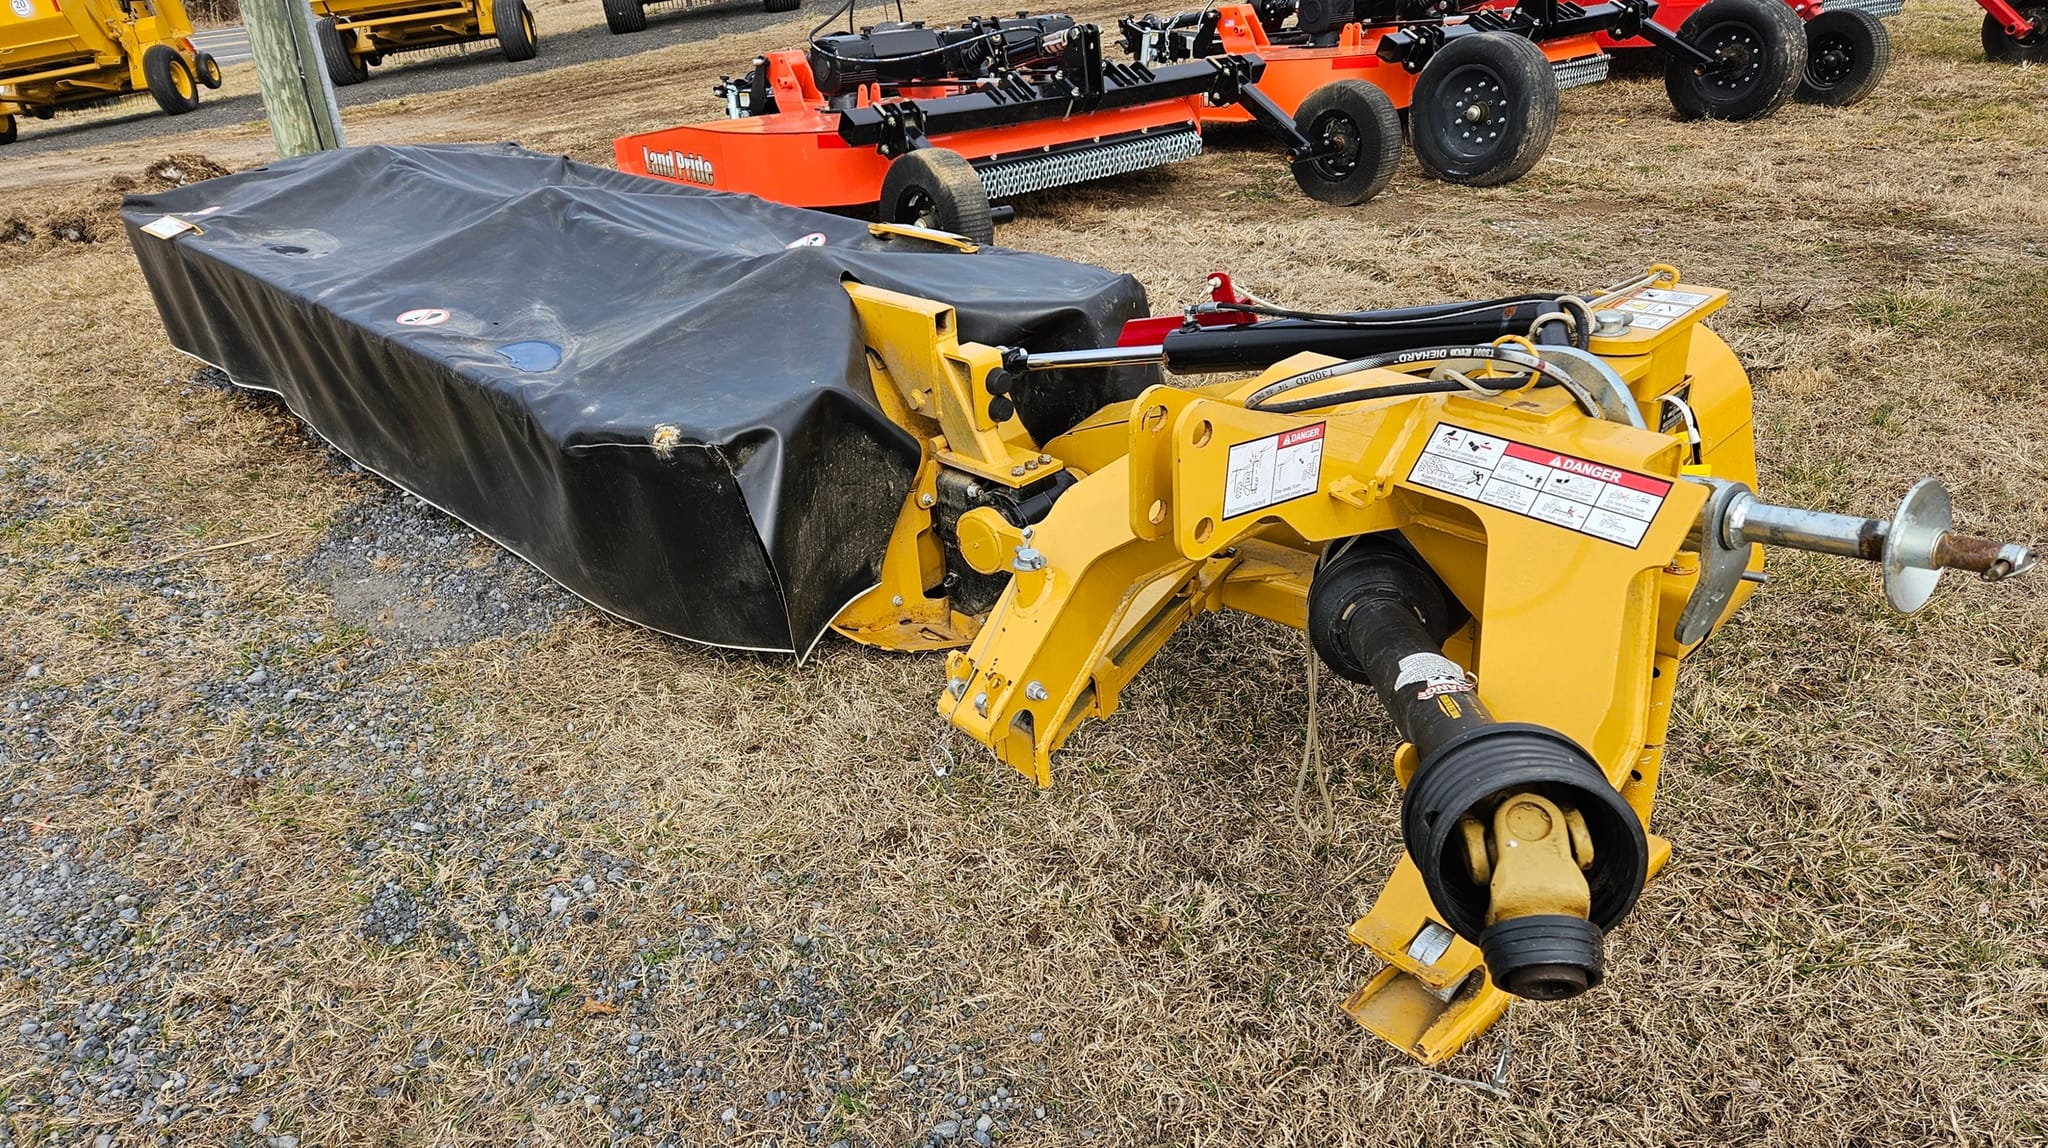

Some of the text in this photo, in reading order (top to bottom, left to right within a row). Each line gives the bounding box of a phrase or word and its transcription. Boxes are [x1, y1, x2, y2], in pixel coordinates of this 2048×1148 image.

[642, 145, 714, 186] Land Pride
[1291, 427, 1320, 443] DANGER
[1564, 460, 1622, 483] DANGER
